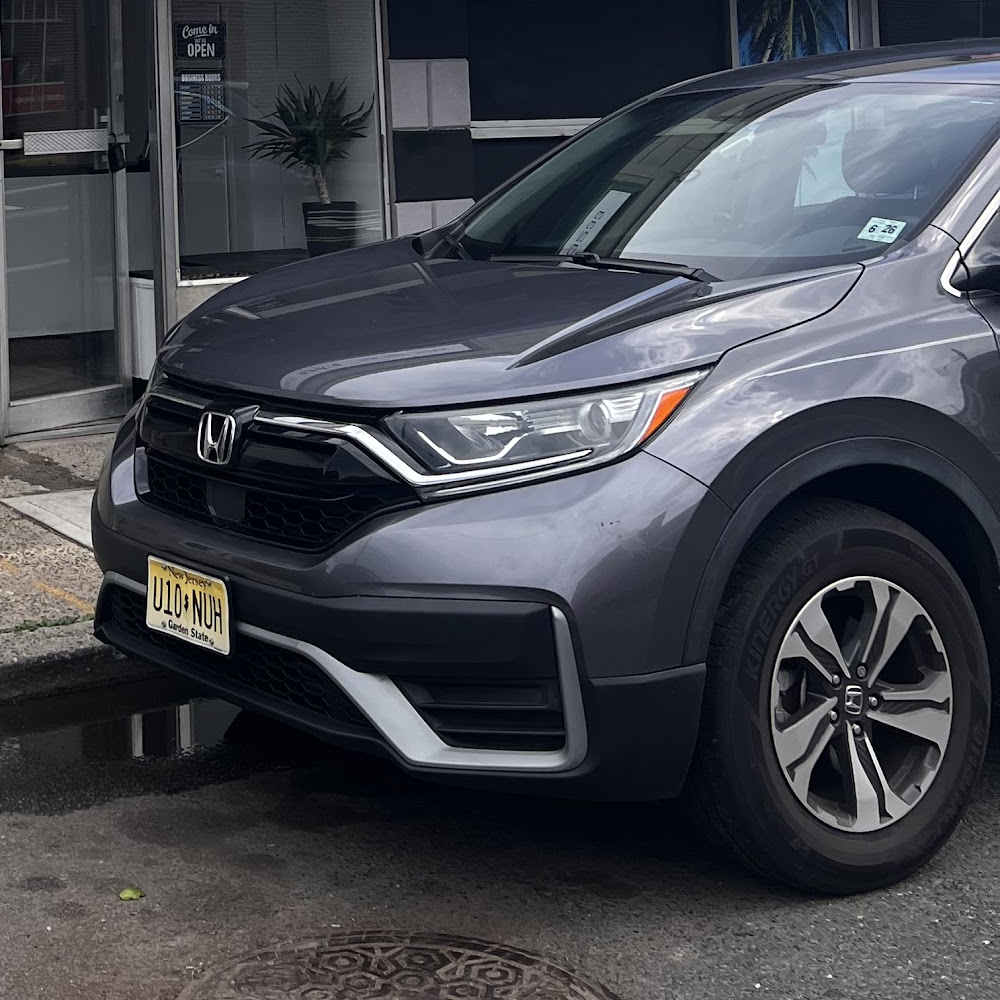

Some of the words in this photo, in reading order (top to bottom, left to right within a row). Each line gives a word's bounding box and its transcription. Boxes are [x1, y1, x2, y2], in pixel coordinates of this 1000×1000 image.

[181, 25, 208, 39] Come
[208, 23, 219, 35] in
[187, 43, 216, 58] OPEN
[181, 73, 205, 82] BUSINESS
[868, 224, 879, 233] 6
[881, 224, 898, 234] 26
[168, 565, 184, 581] New
[183, 571, 207, 589] Jersey
[168, 619, 188, 635] Garden
[190, 628, 209, 642] State
